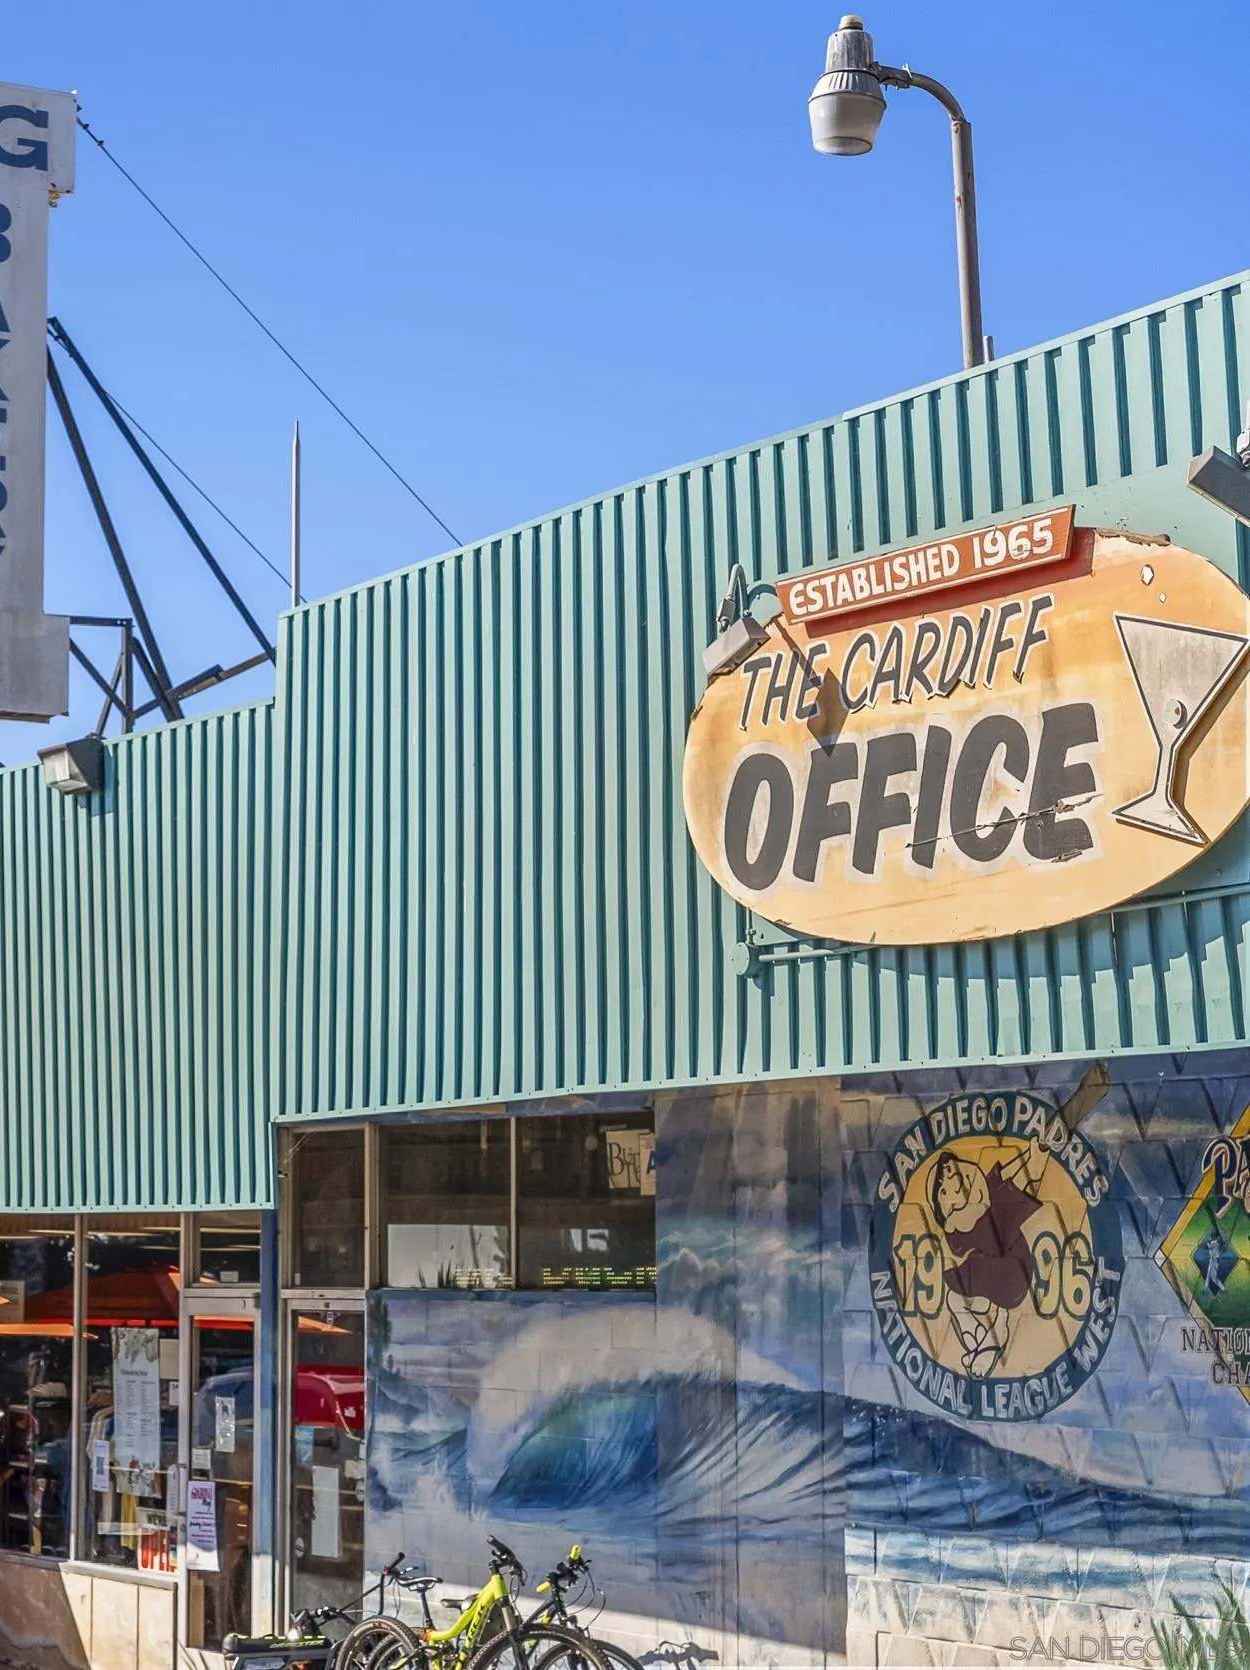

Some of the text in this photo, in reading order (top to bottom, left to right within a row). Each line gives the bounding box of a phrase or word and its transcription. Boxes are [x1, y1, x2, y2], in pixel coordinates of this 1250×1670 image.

[789, 518, 1054, 616] ESTABLISHED 1965
[740, 597, 1054, 731] THE CARDIFF
[723, 702, 1100, 891] OFFICE
[878, 1096, 1110, 1213] SAN DIEGO PADRES
[871, 1257, 1121, 1418] NATIONAL LEAGUE WEST
[893, 1231, 1094, 1321] 19 96
